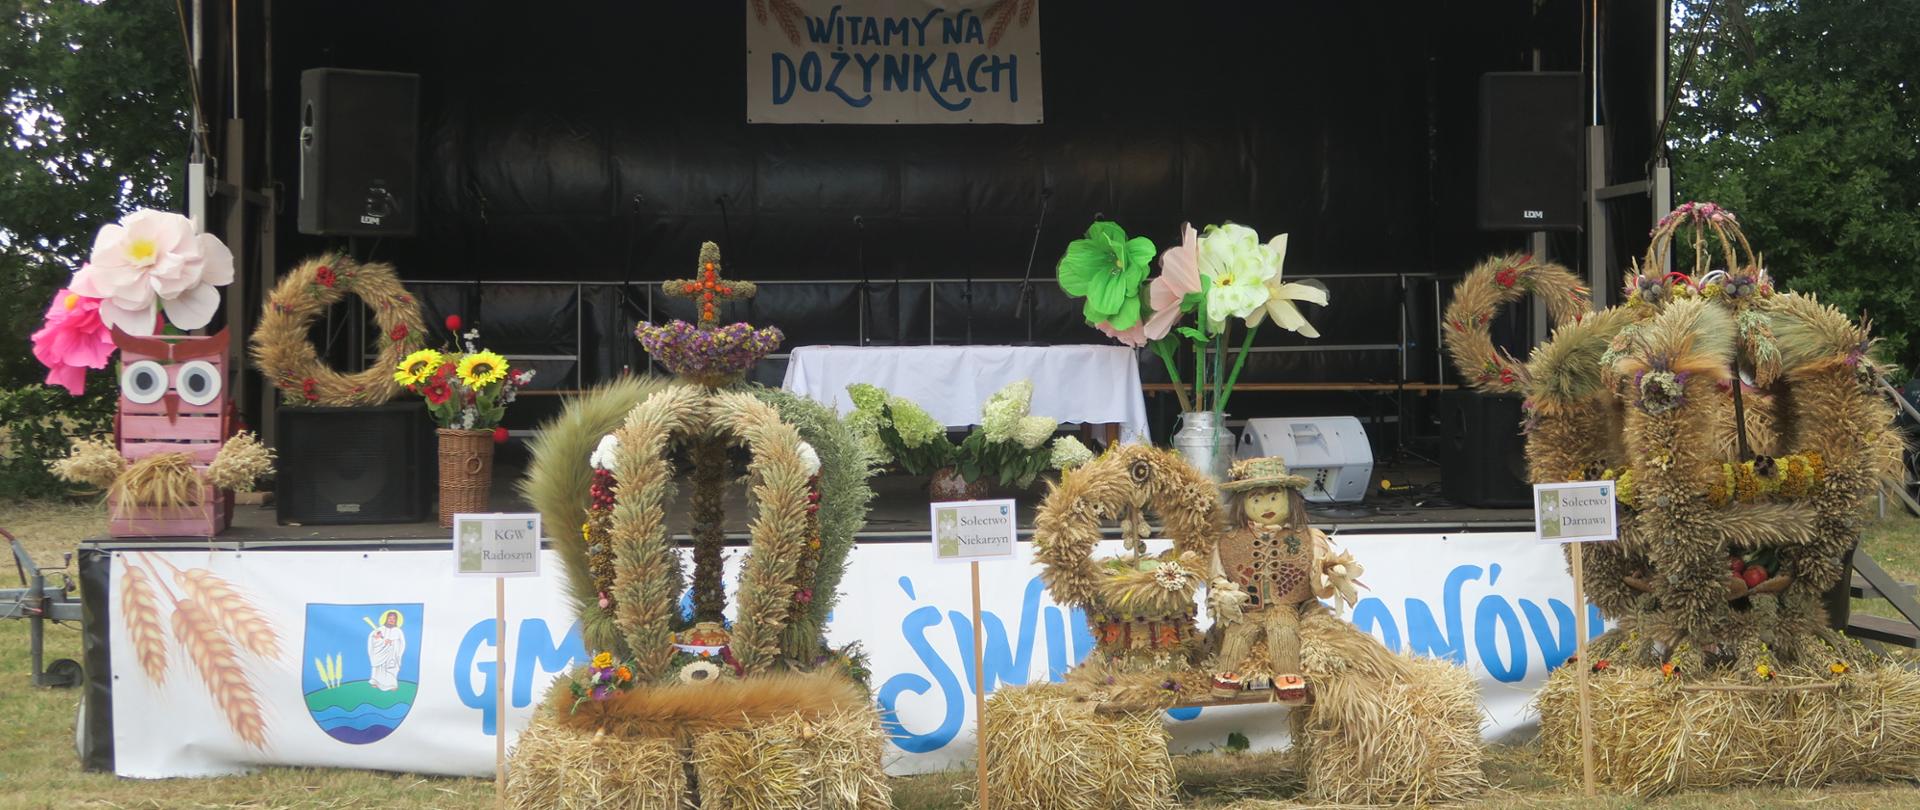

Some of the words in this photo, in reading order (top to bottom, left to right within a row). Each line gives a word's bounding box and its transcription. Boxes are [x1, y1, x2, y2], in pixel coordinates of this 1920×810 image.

[804, 5, 944, 46] WITAMY
[942, 8, 985, 45] NA
[771, 46, 1018, 112] DOŻYNKACH
[494, 529, 525, 541] KGW
[956, 535, 1009, 547] Niekarzyn
[482, 549, 533, 563] Radoszyn
